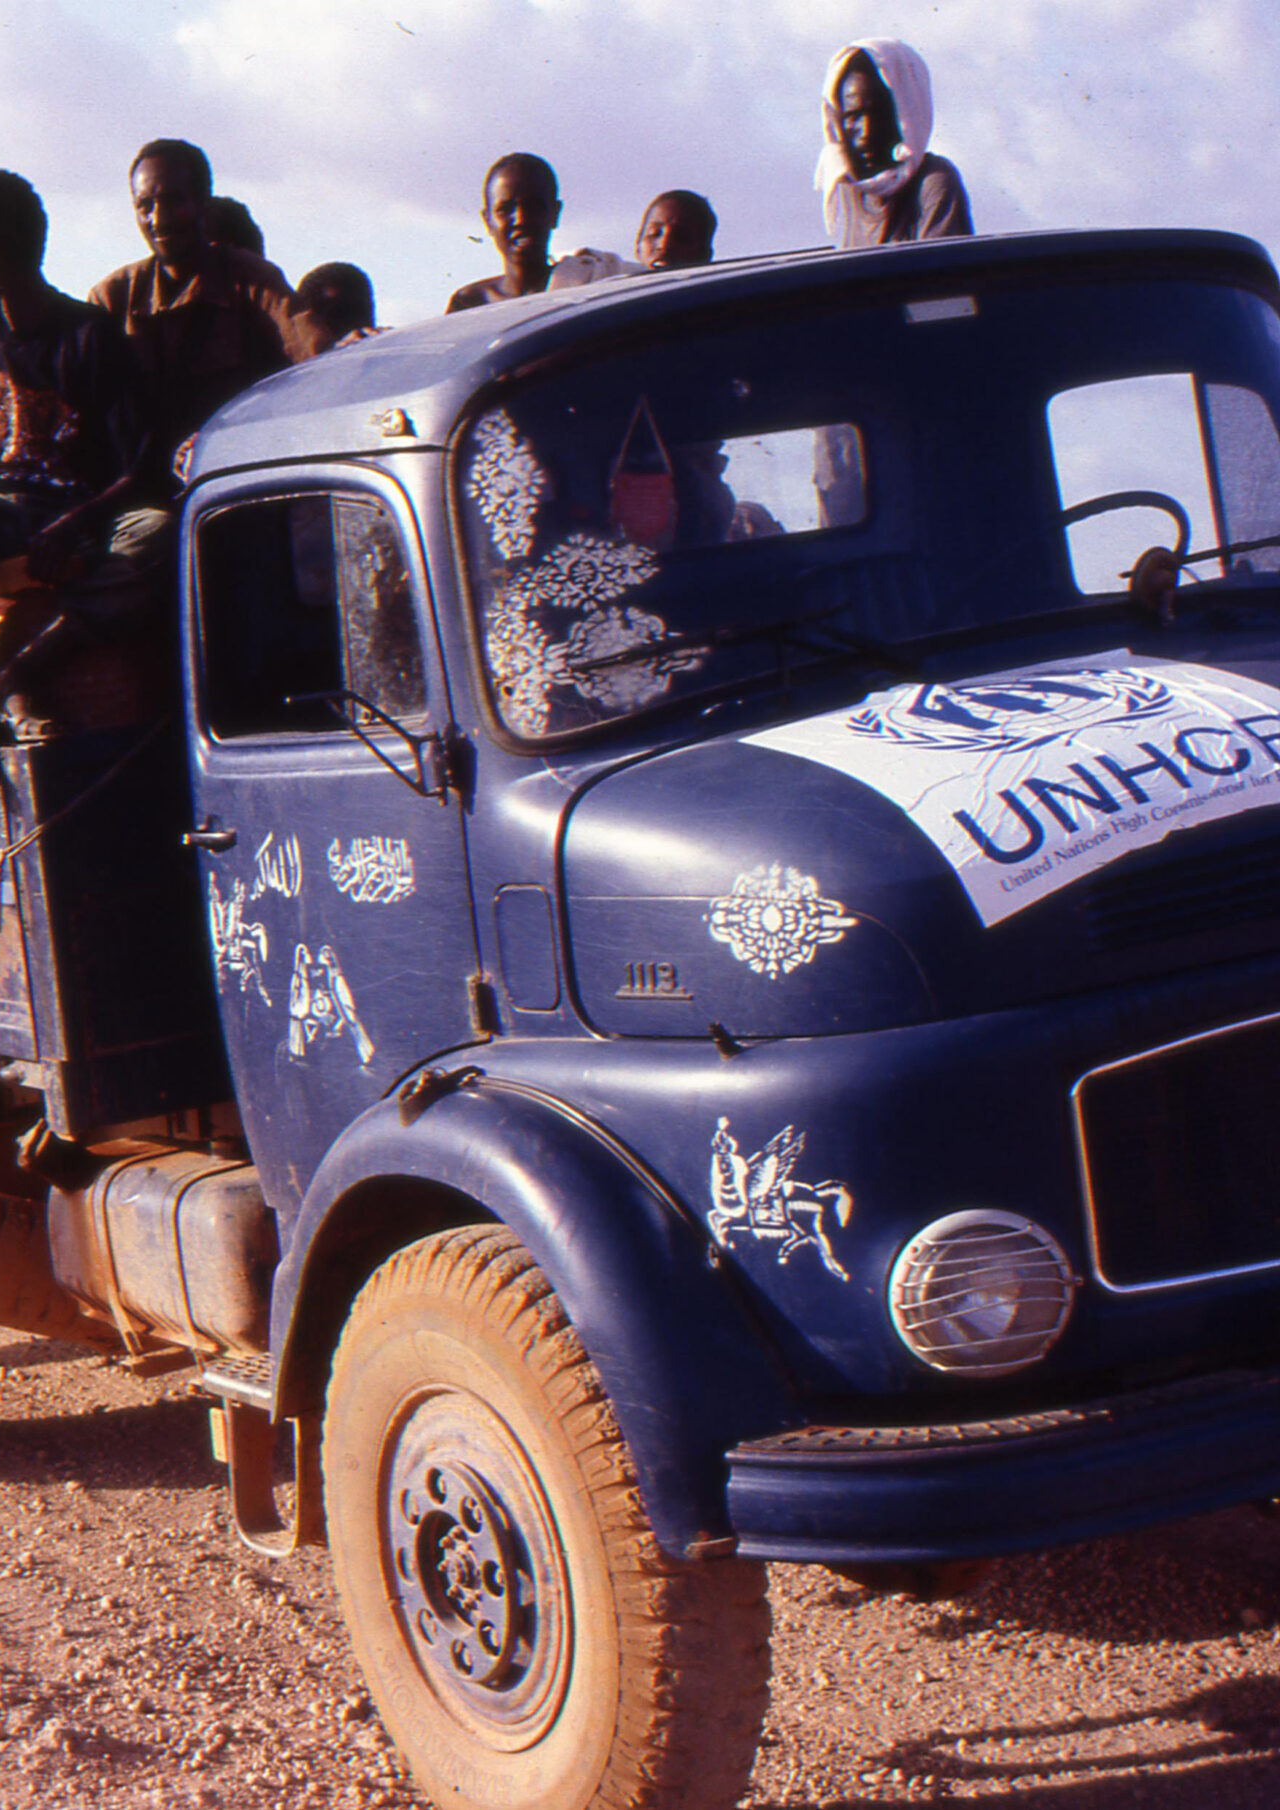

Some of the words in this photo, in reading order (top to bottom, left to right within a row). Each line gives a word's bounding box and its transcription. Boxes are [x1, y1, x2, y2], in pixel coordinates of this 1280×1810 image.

[1000, 855, 1053, 892] United
[1053, 829, 1111, 865] Nations
[1110, 811, 1149, 834] High
